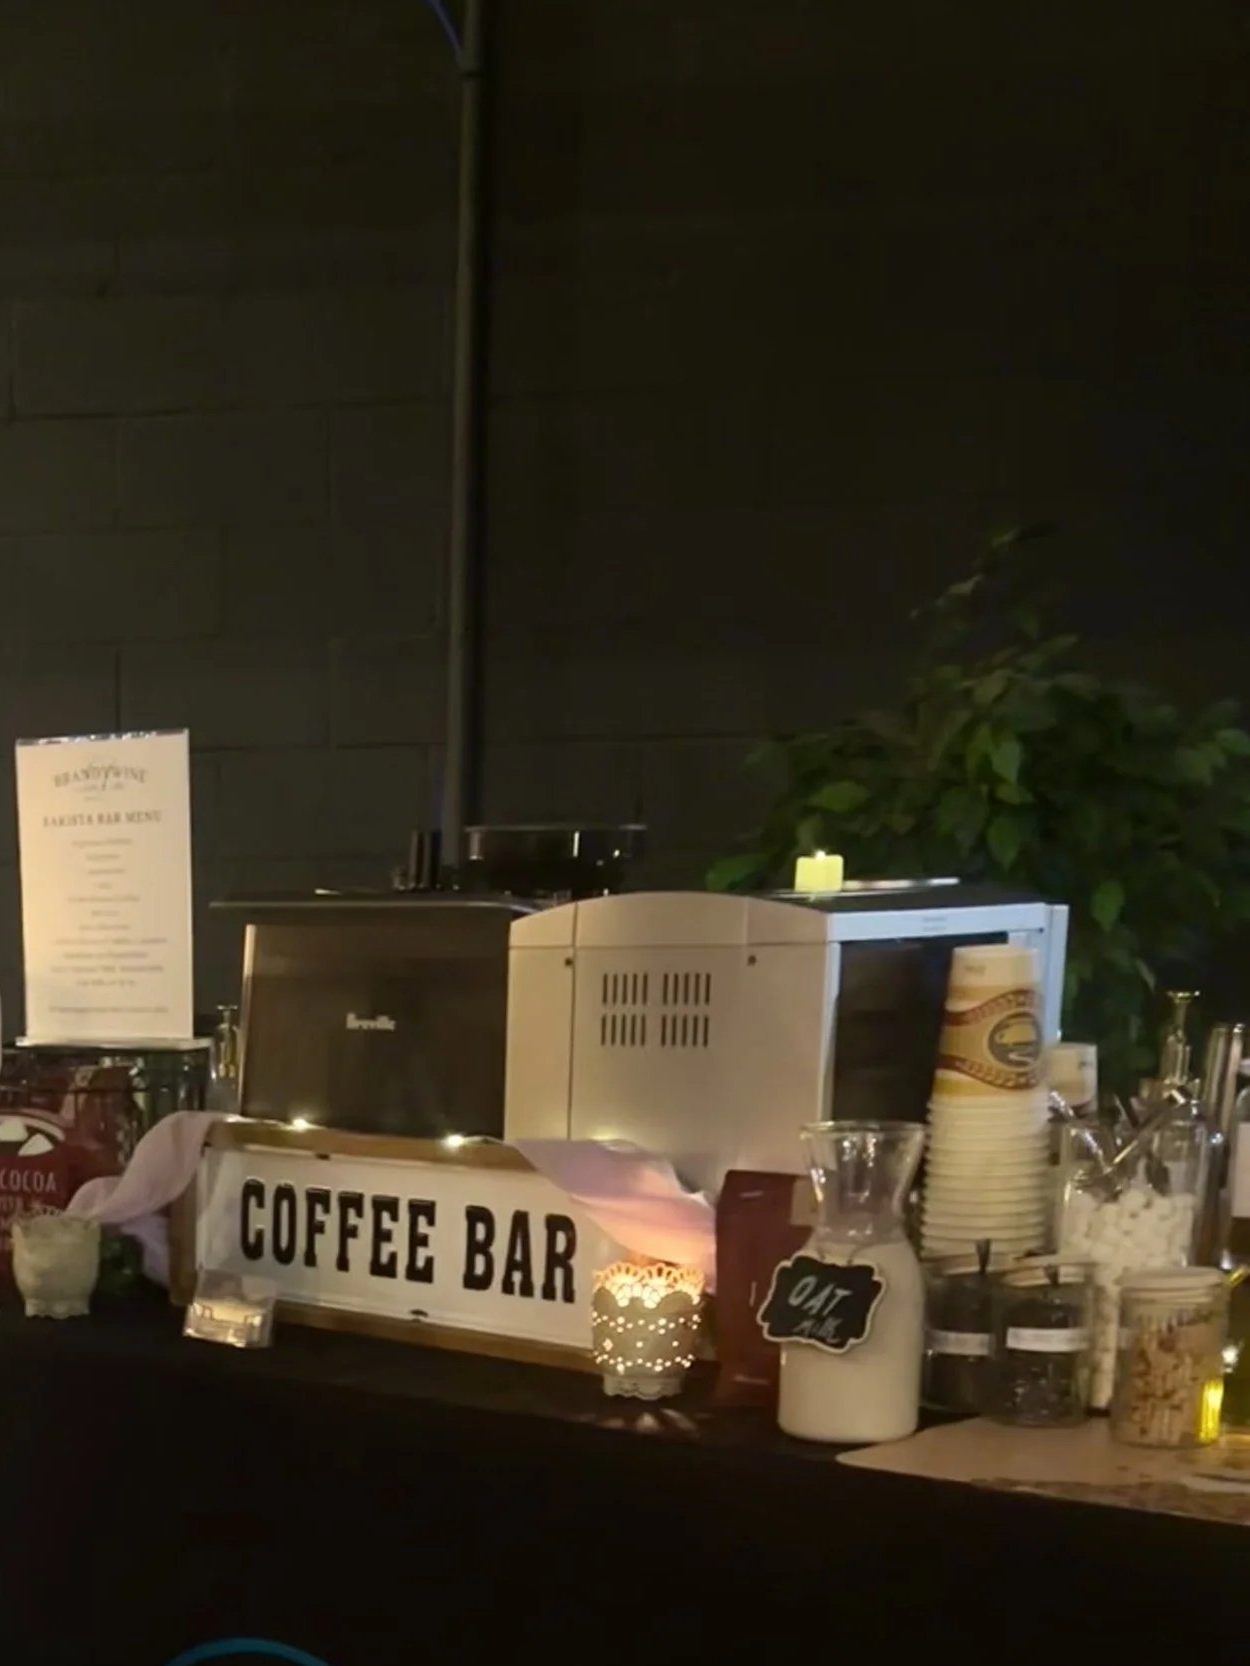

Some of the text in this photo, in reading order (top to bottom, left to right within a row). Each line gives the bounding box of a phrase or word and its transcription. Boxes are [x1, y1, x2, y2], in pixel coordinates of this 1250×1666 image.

[240, 1178, 576, 1304] COFFEE BAR
[787, 1274, 853, 1316] OAT
